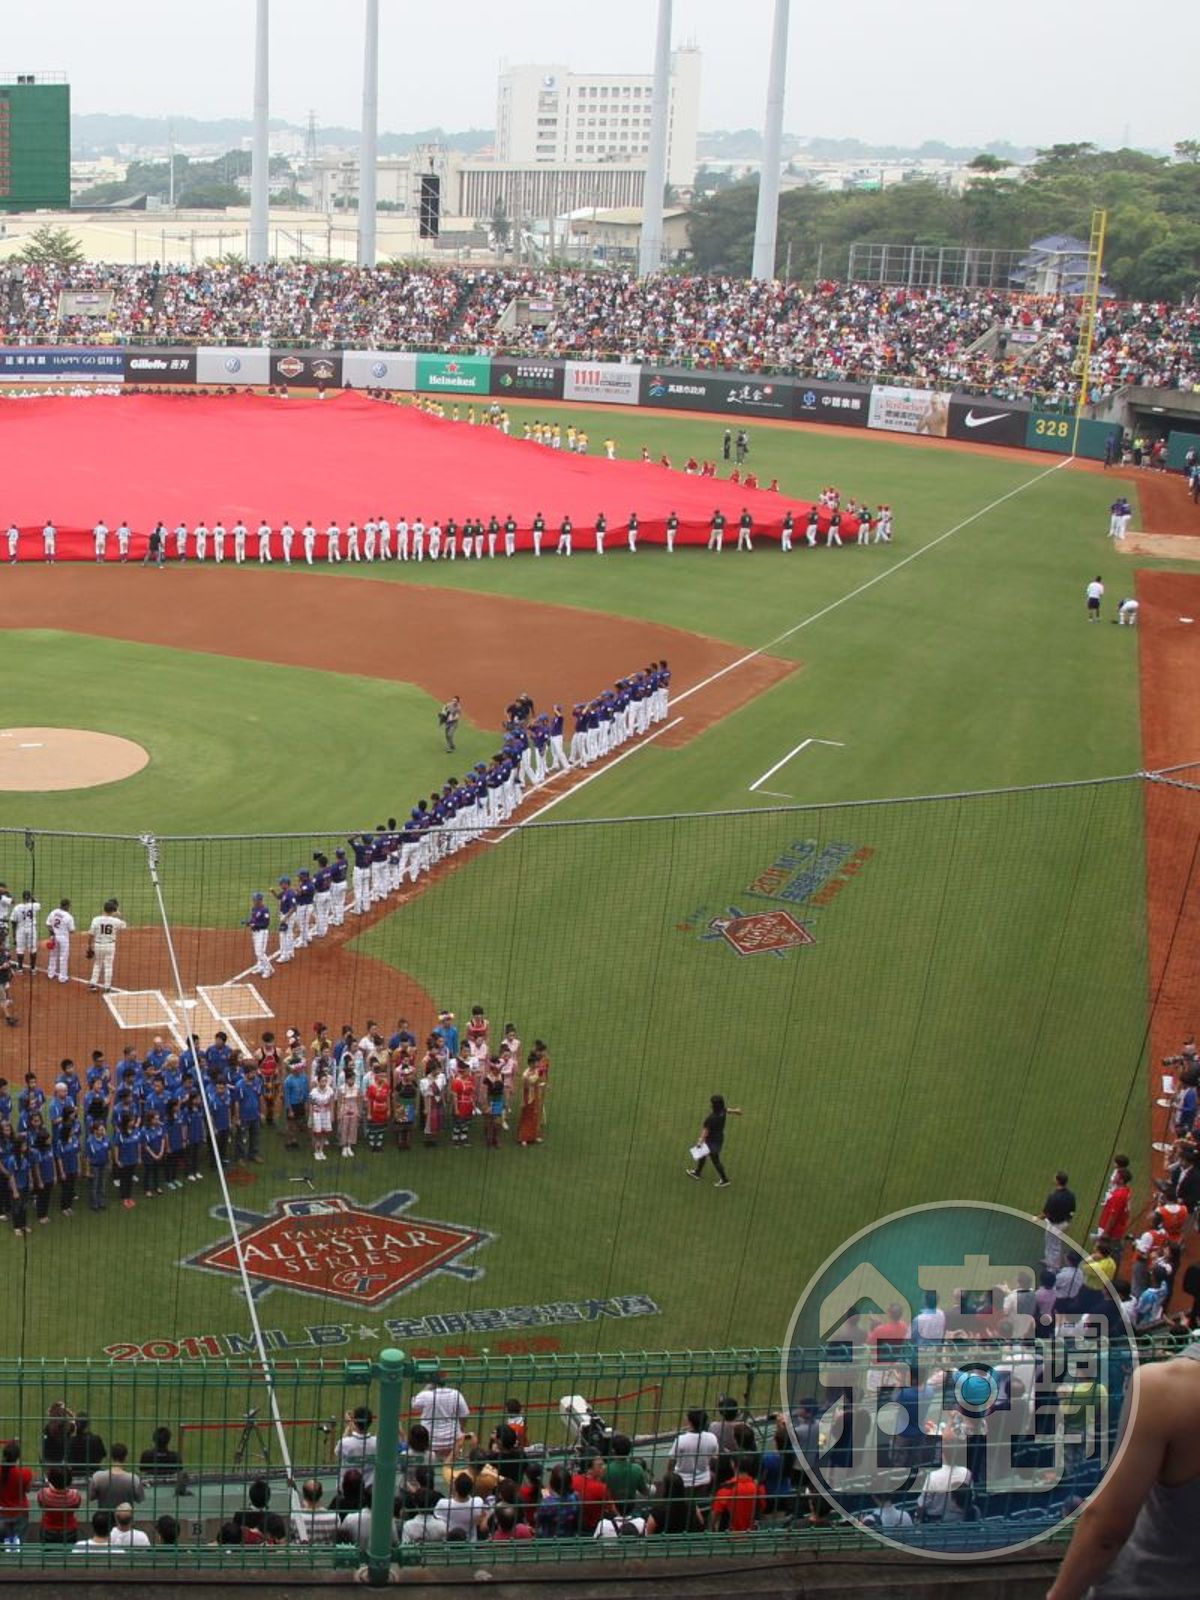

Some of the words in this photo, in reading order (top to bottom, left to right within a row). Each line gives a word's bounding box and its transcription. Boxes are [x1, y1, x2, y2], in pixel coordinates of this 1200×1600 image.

[53, 357, 81, 365] HAPPY
[82, 357, 96, 365] GO
[130, 359, 168, 370] Gillette
[429, 375, 477, 387] Heineken
[1036, 419, 1068, 436] 328
[100, 924, 113, 934] 16
[281, 1224, 373, 1240] TAIWAN
[285, 1251, 402, 1273] SERIES
[103, 1335, 225, 1361] 2011
[222, 1324, 352, 1355] MLB
